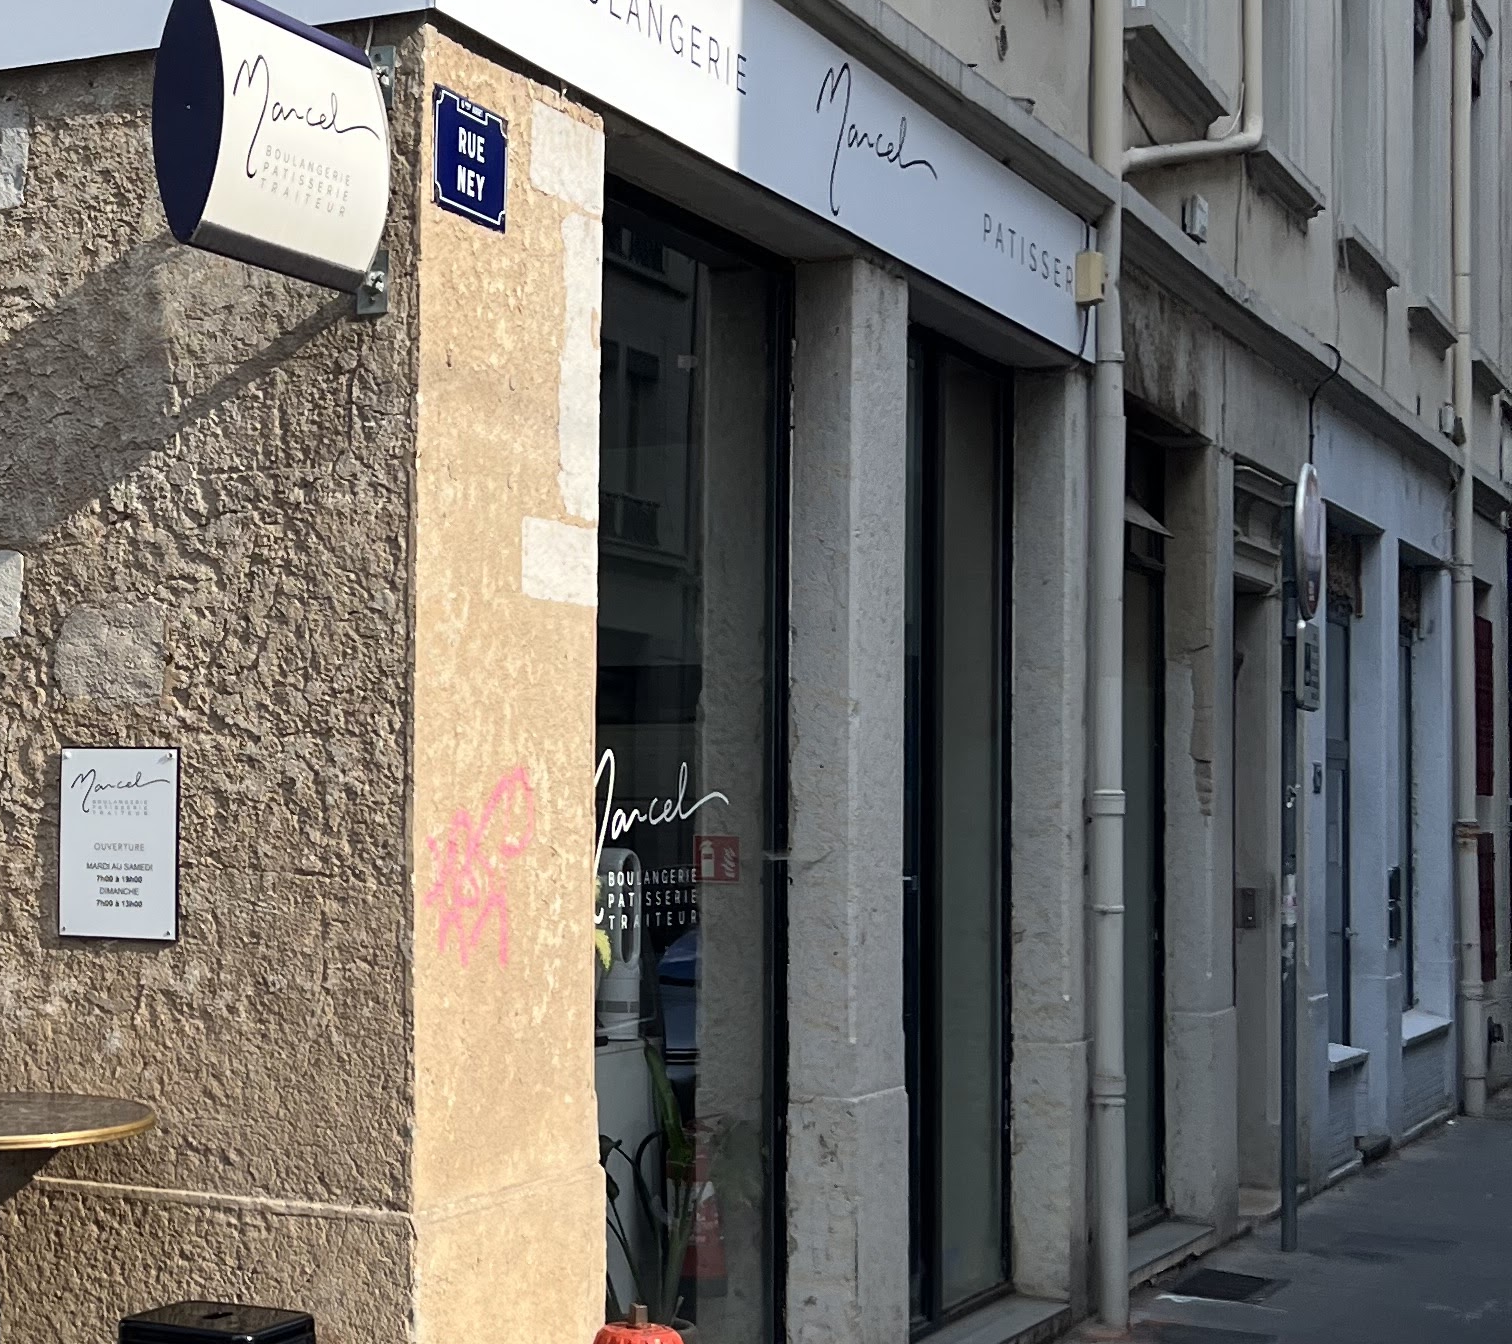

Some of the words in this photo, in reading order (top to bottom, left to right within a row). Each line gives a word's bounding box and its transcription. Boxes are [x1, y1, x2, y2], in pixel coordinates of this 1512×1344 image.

[232, 54, 381, 179] Marcel
[458, 126, 486, 164] RUE
[816, 62, 938, 217] Marcel
[263, 161, 349, 202] PATISSERIE
[265, 144, 350, 187] BOULANGERIE
[456, 164, 486, 202] NEY
[260, 177, 346, 217] TRAITEUR
[983, 211, 1074, 297] PATISSER
[71, 768, 171, 813] Marcel
[86, 862, 110, 870] MARDI
[123, 863, 154, 871] SAMEDI
[93, 842, 145, 852] OUVERTURE
[99, 887, 140, 896] DIMANCHE
[608, 889, 697, 908] PATSSERIE
[608, 909, 697, 930] TRAITEUR
